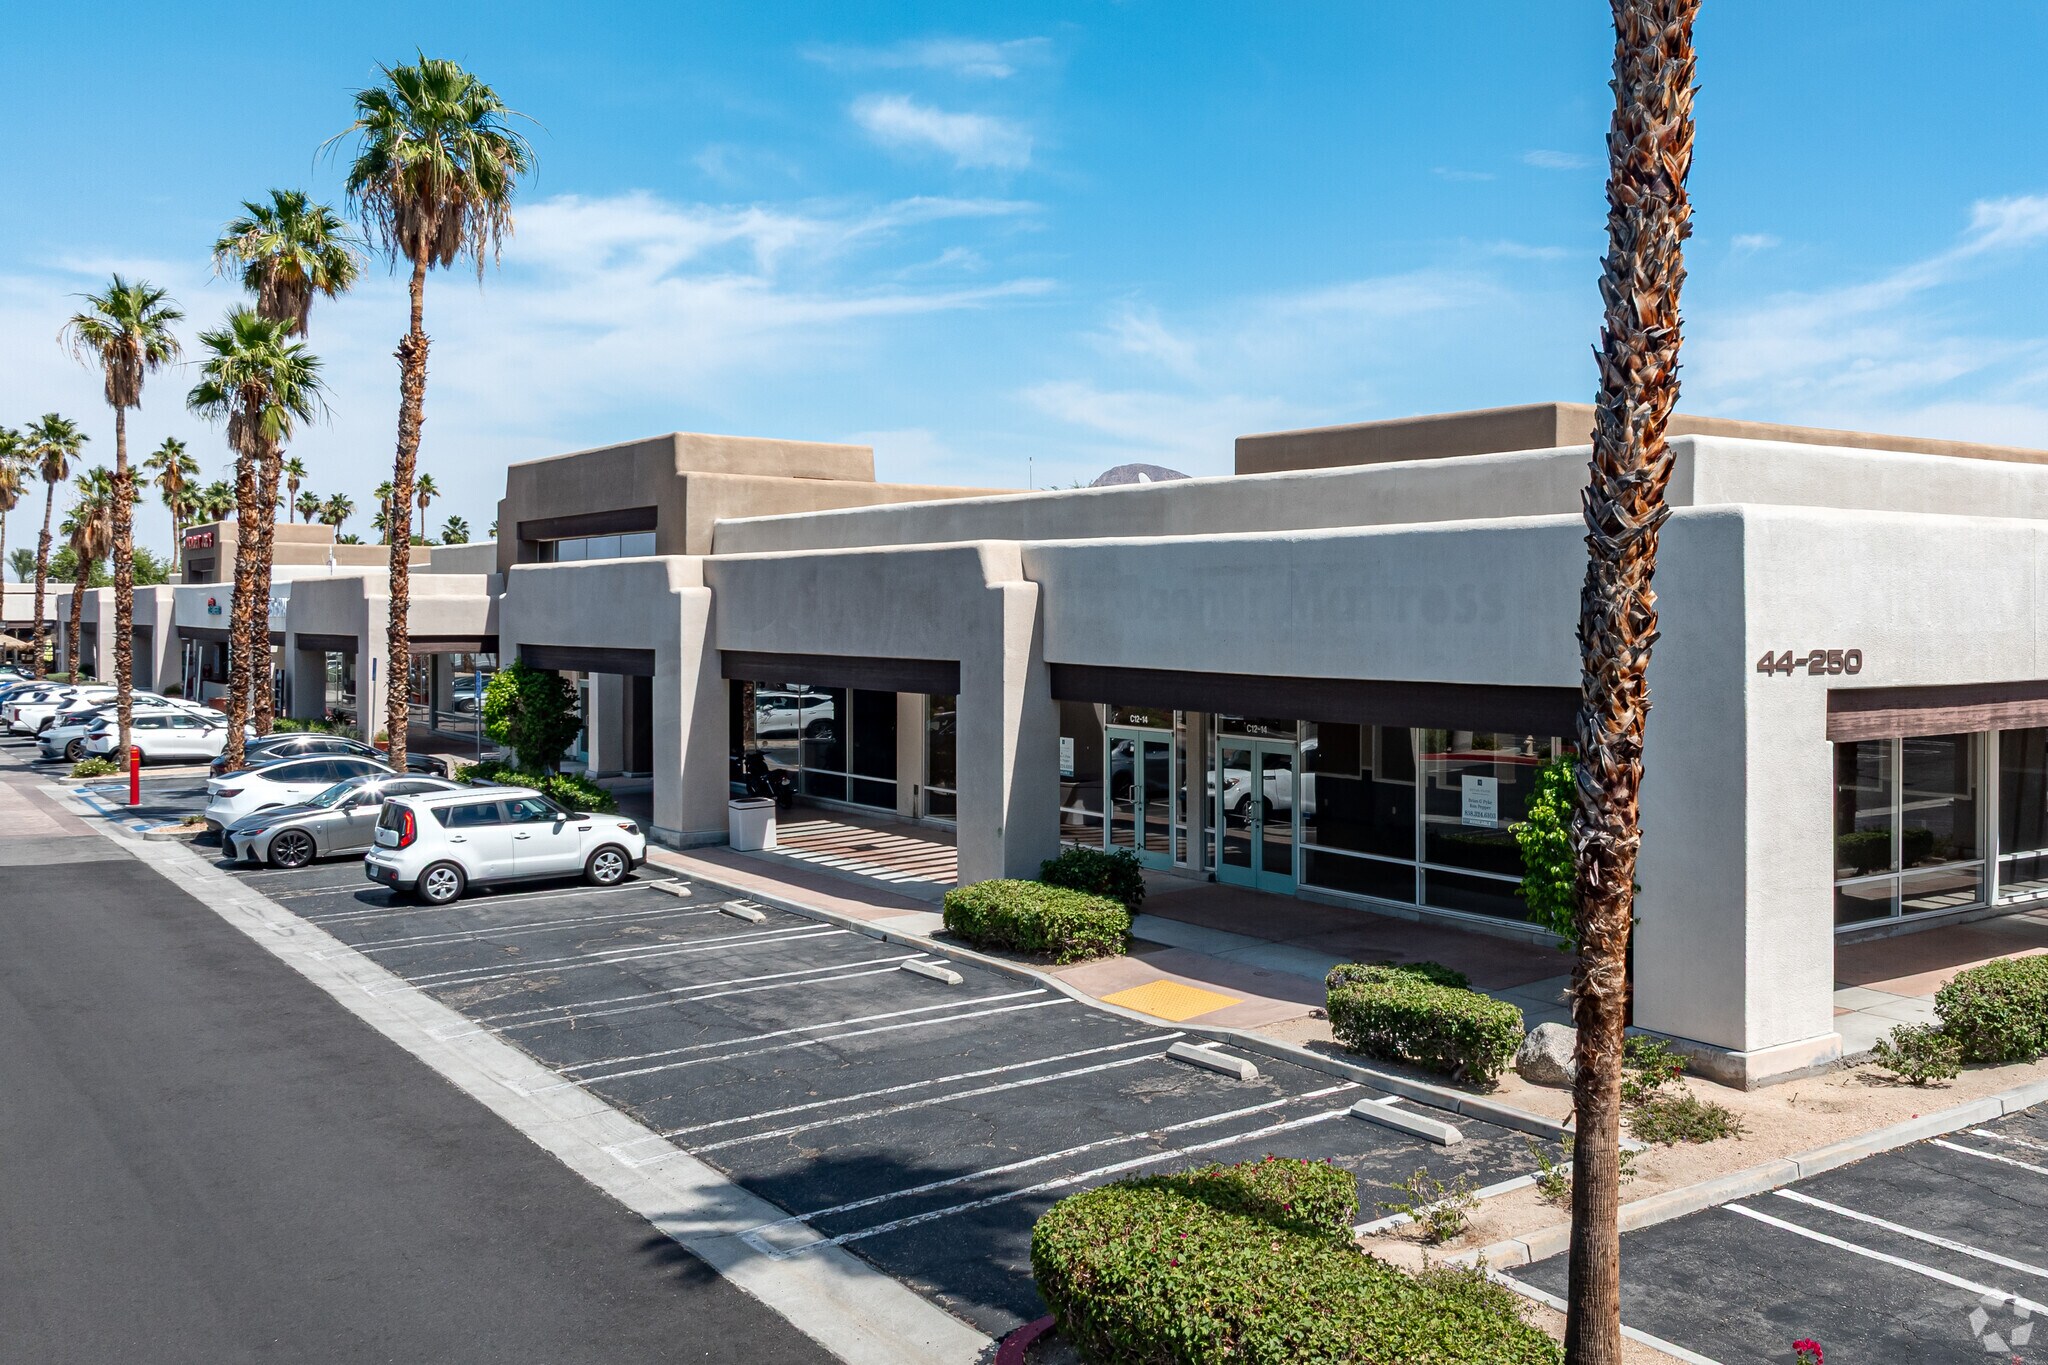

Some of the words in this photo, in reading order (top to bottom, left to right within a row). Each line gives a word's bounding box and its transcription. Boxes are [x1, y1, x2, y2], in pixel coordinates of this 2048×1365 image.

[1756, 649, 1862, 677] 44-250
[1130, 714, 1148, 724] C12-14
[1246, 724, 1268, 734] C12-14
